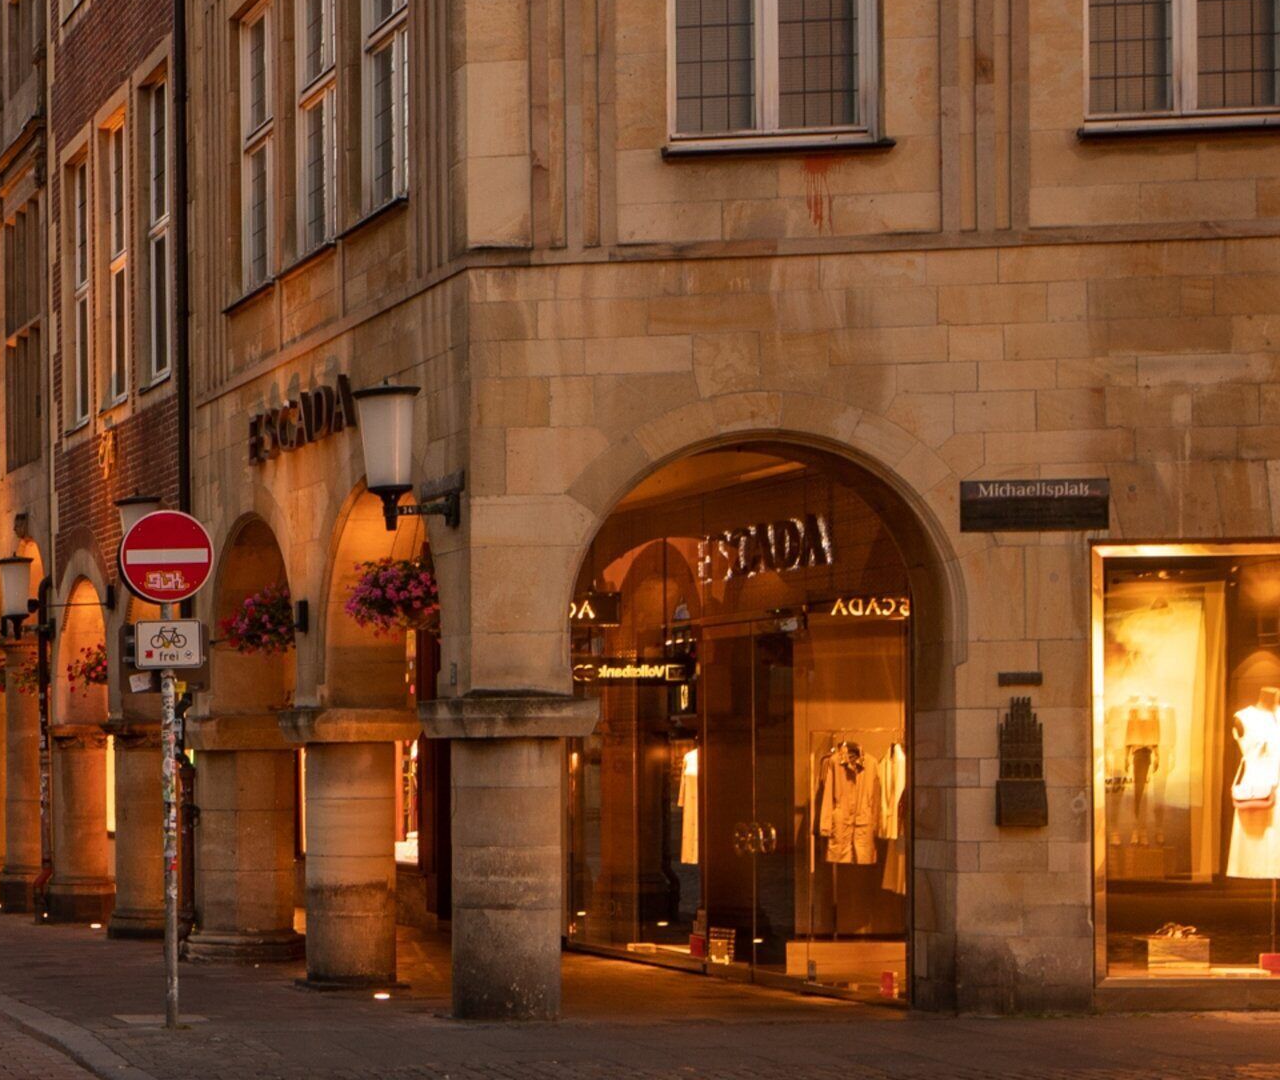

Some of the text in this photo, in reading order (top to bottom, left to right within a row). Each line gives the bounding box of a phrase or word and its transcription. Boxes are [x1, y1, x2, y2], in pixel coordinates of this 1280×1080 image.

[248, 374, 358, 467] ESCADA
[696, 513, 833, 584] ESCADA
[159, 650, 180, 662] frei
